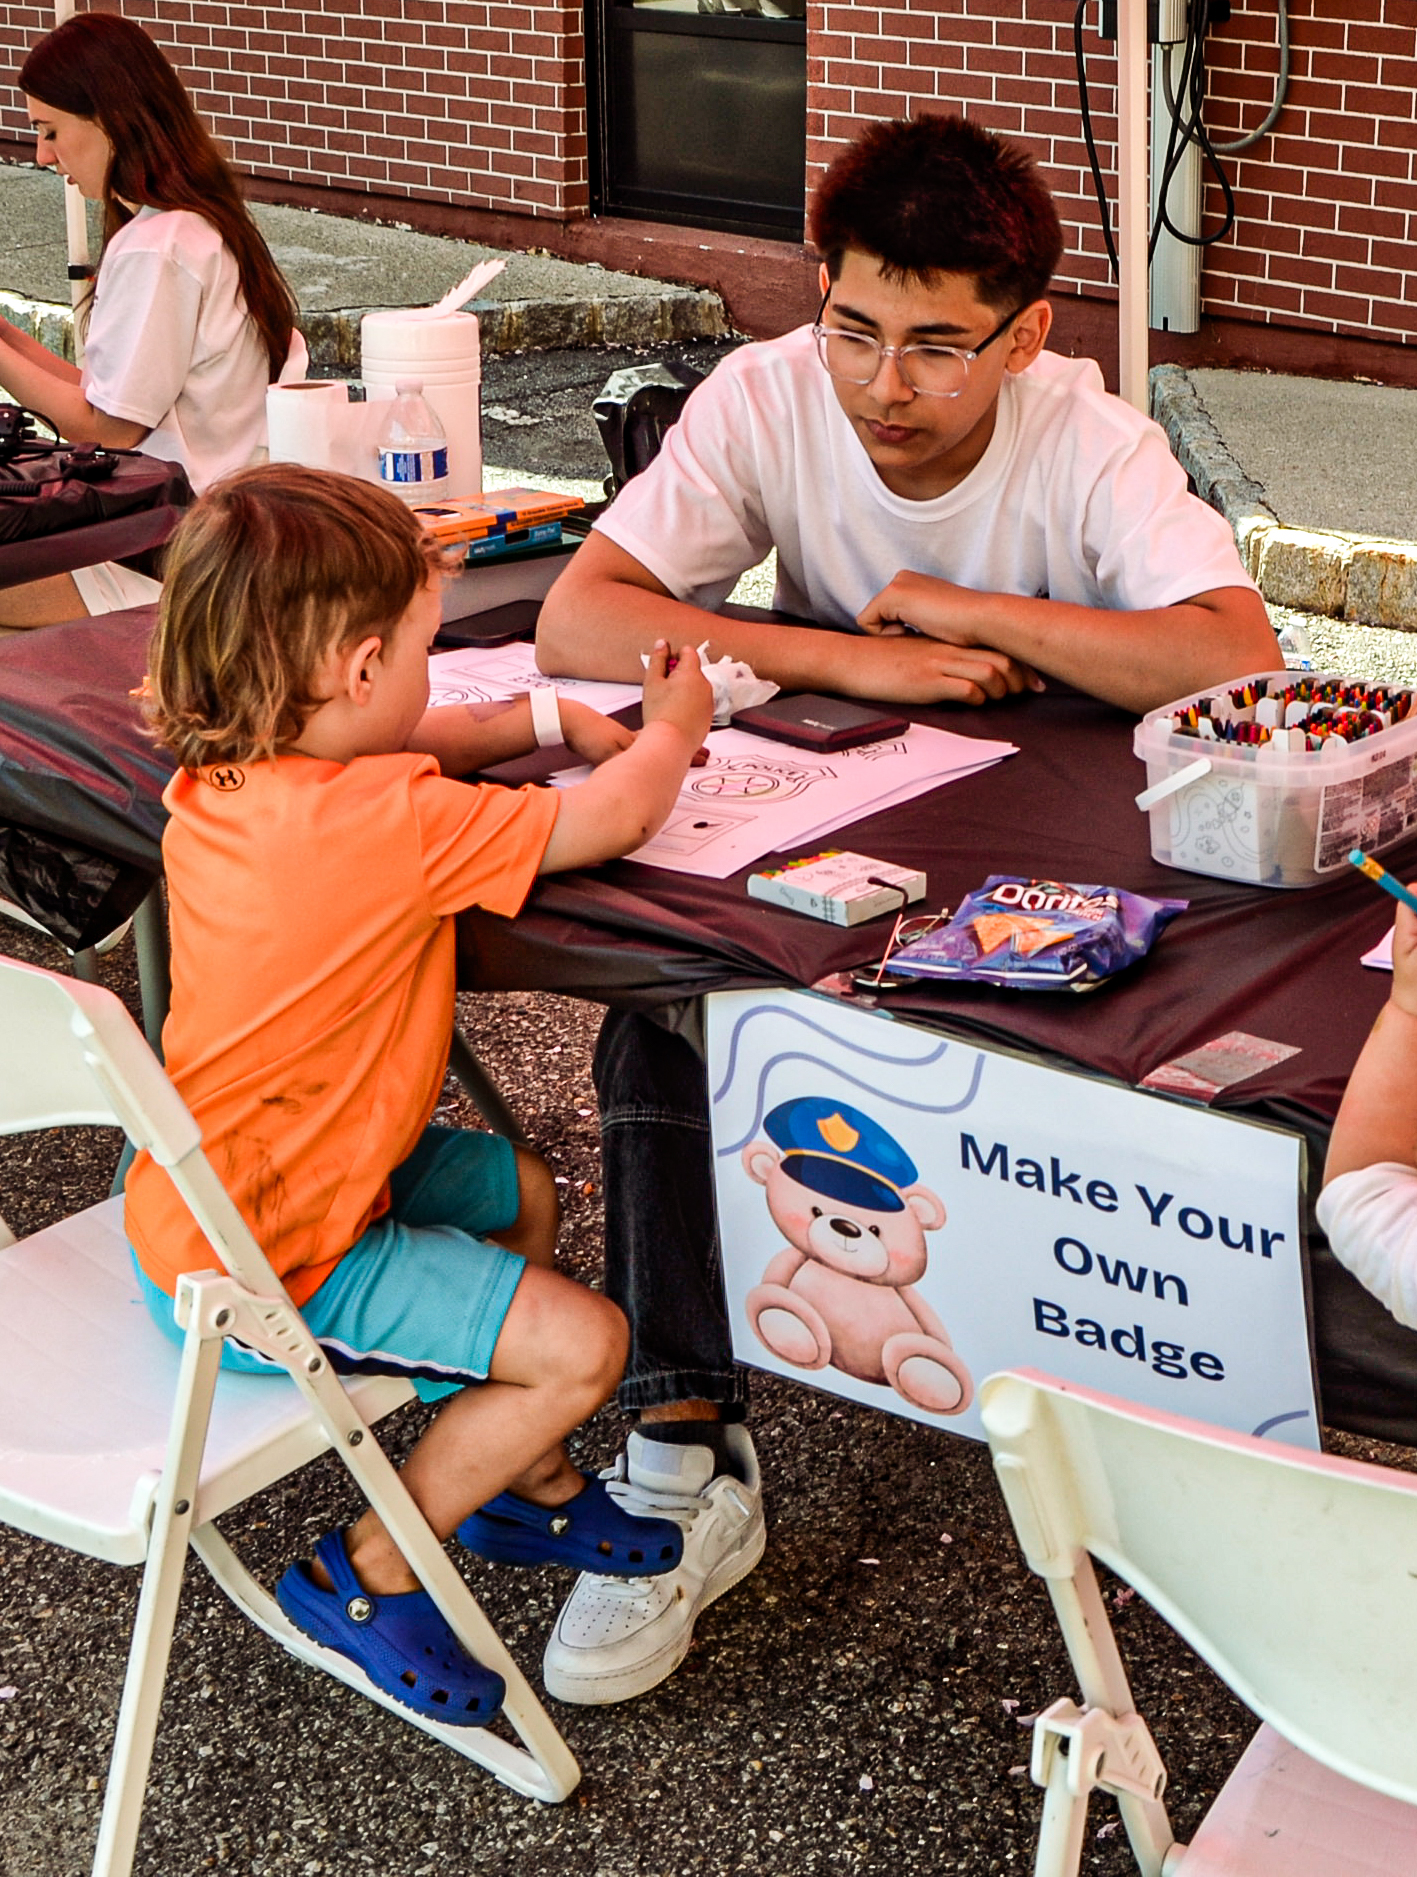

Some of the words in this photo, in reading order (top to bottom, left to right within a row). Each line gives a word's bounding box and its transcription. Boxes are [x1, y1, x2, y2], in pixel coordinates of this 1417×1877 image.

[959, 1131, 1119, 1214] Make
[1135, 1183, 1286, 1260] Your
[1053, 1236, 1190, 1308] Own
[1031, 1297, 1226, 1382] Badge
